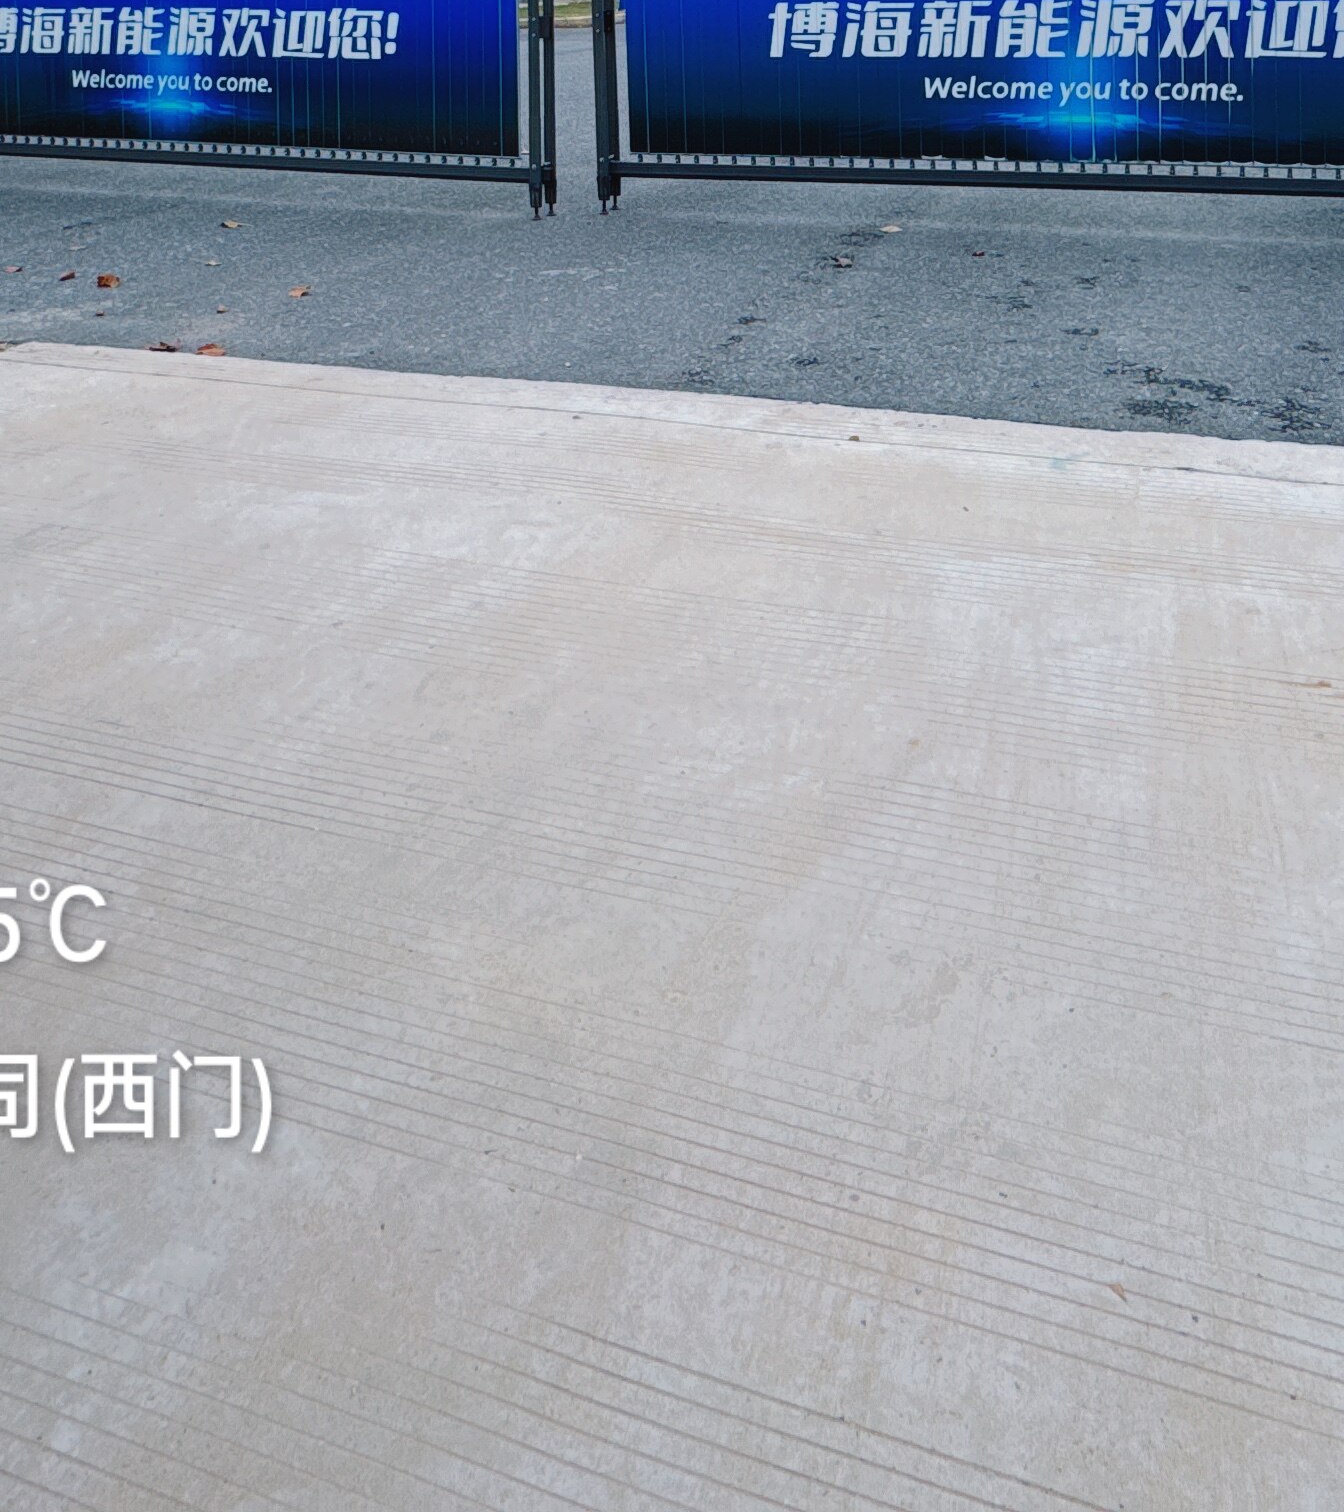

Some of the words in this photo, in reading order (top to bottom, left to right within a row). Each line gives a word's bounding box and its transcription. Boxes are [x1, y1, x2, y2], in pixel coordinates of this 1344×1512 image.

[71, 69, 154, 90] Welcome
[157, 75, 190, 95] you
[194, 73, 213, 91] to
[216, 76, 273, 93] come.
[924, 76, 1053, 99] Welcome
[1059, 82, 1111, 107] you
[1119, 78, 1149, 100] to
[1154, 82, 1244, 102] come.
